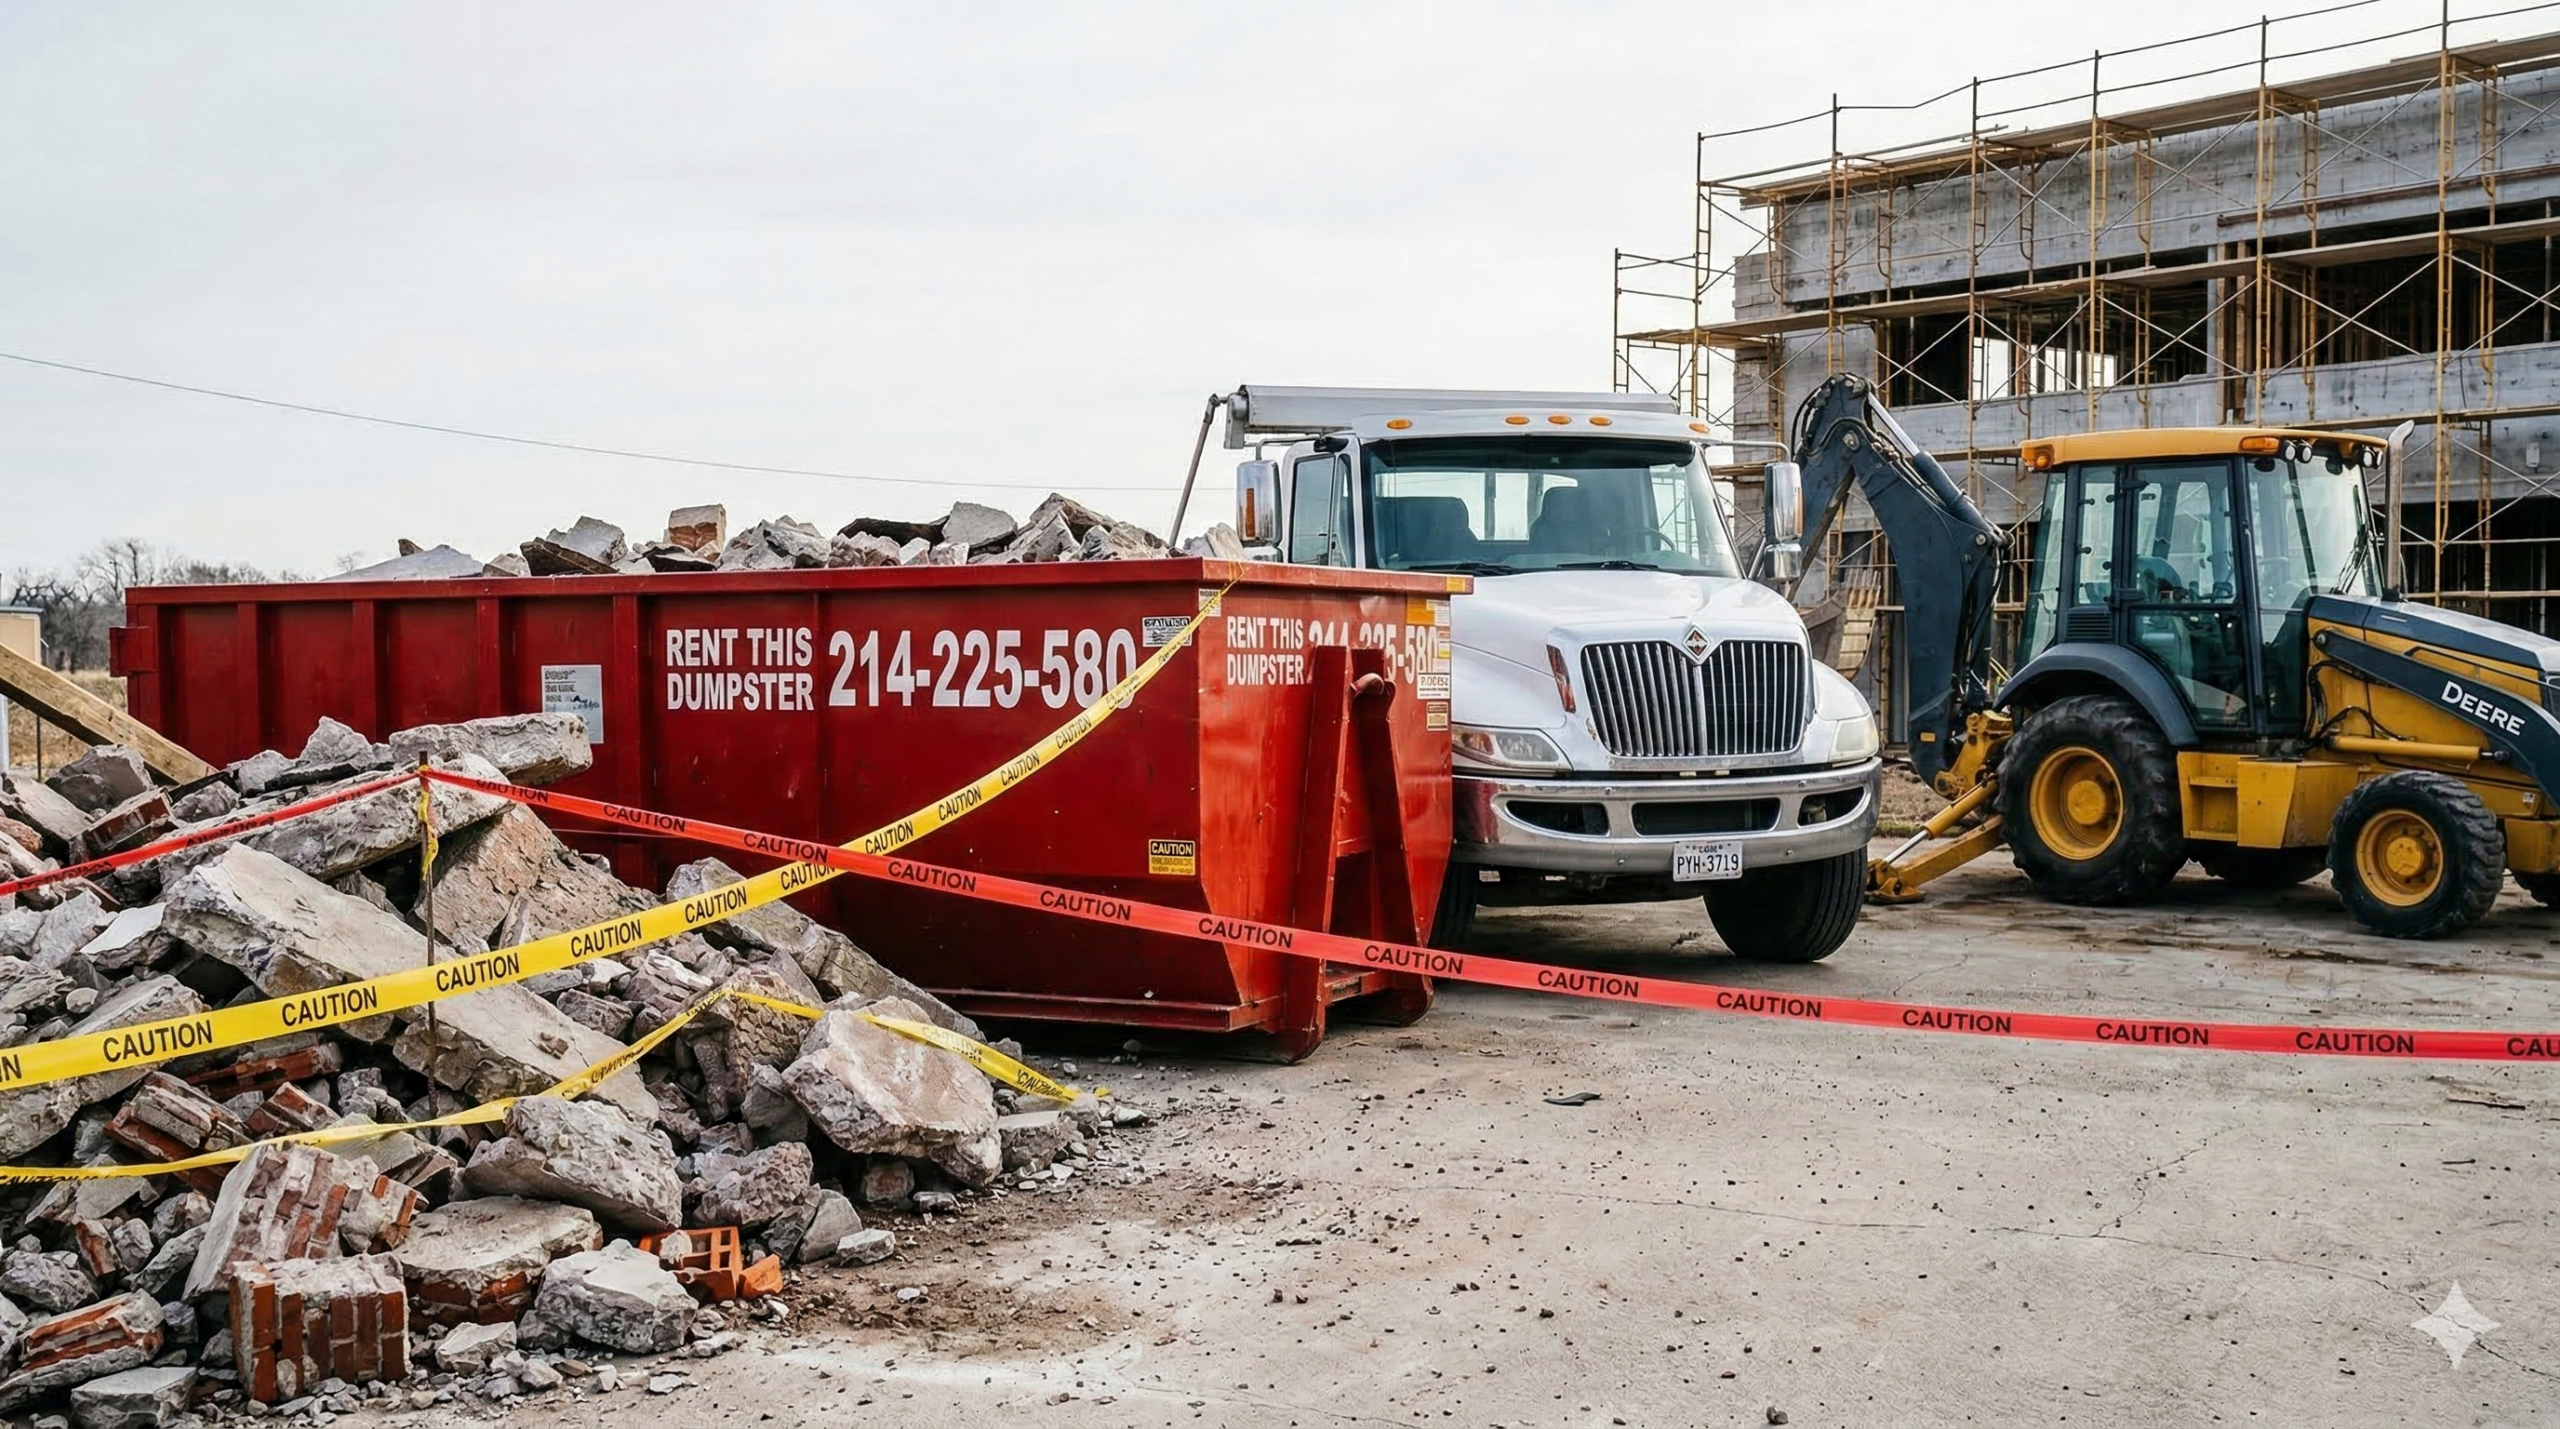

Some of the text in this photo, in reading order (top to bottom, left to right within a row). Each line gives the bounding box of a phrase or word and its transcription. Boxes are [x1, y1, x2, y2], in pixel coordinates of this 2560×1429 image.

[667, 627, 812, 667] RENT THIS
[1227, 616, 1267, 648] RENT
[1270, 617, 1304, 650] THIS
[829, 629, 1136, 709] 214-225-580
[1227, 654, 1304, 685] DUMPSTER
[667, 672, 814, 711] DUMPSTER
[2441, 680, 2525, 736] DEERE
[1151, 842, 1193, 855] CAUTION
[103, 1019, 213, 1063] CAUTION
[281, 986, 378, 1026] CAUTION
[436, 952, 520, 992] CAUTION
[570, 919, 642, 958] CAUTION
[684, 886, 747, 923] CAUTION
[865, 820, 914, 855] CAUTION
[938, 785, 982, 821] CAUTION
[1000, 750, 1041, 786] CAUTION
[603, 804, 686, 833] CAUTION
[743, 833, 829, 863] CAUTION
[887, 861, 977, 892] CAUTION
[1040, 890, 1132, 921] CAUTION
[1197, 918, 1293, 949] CAUTION
[1364, 944, 1463, 975] CAUTION
[1537, 969, 1639, 998] CAUTION
[1716, 992, 1822, 1018] CAUTION
[1902, 1009, 2011, 1033] CAUTION
[2095, 1022, 2209, 1046] CAUTION
[2295, 1031, 2414, 1054] CAUTION
